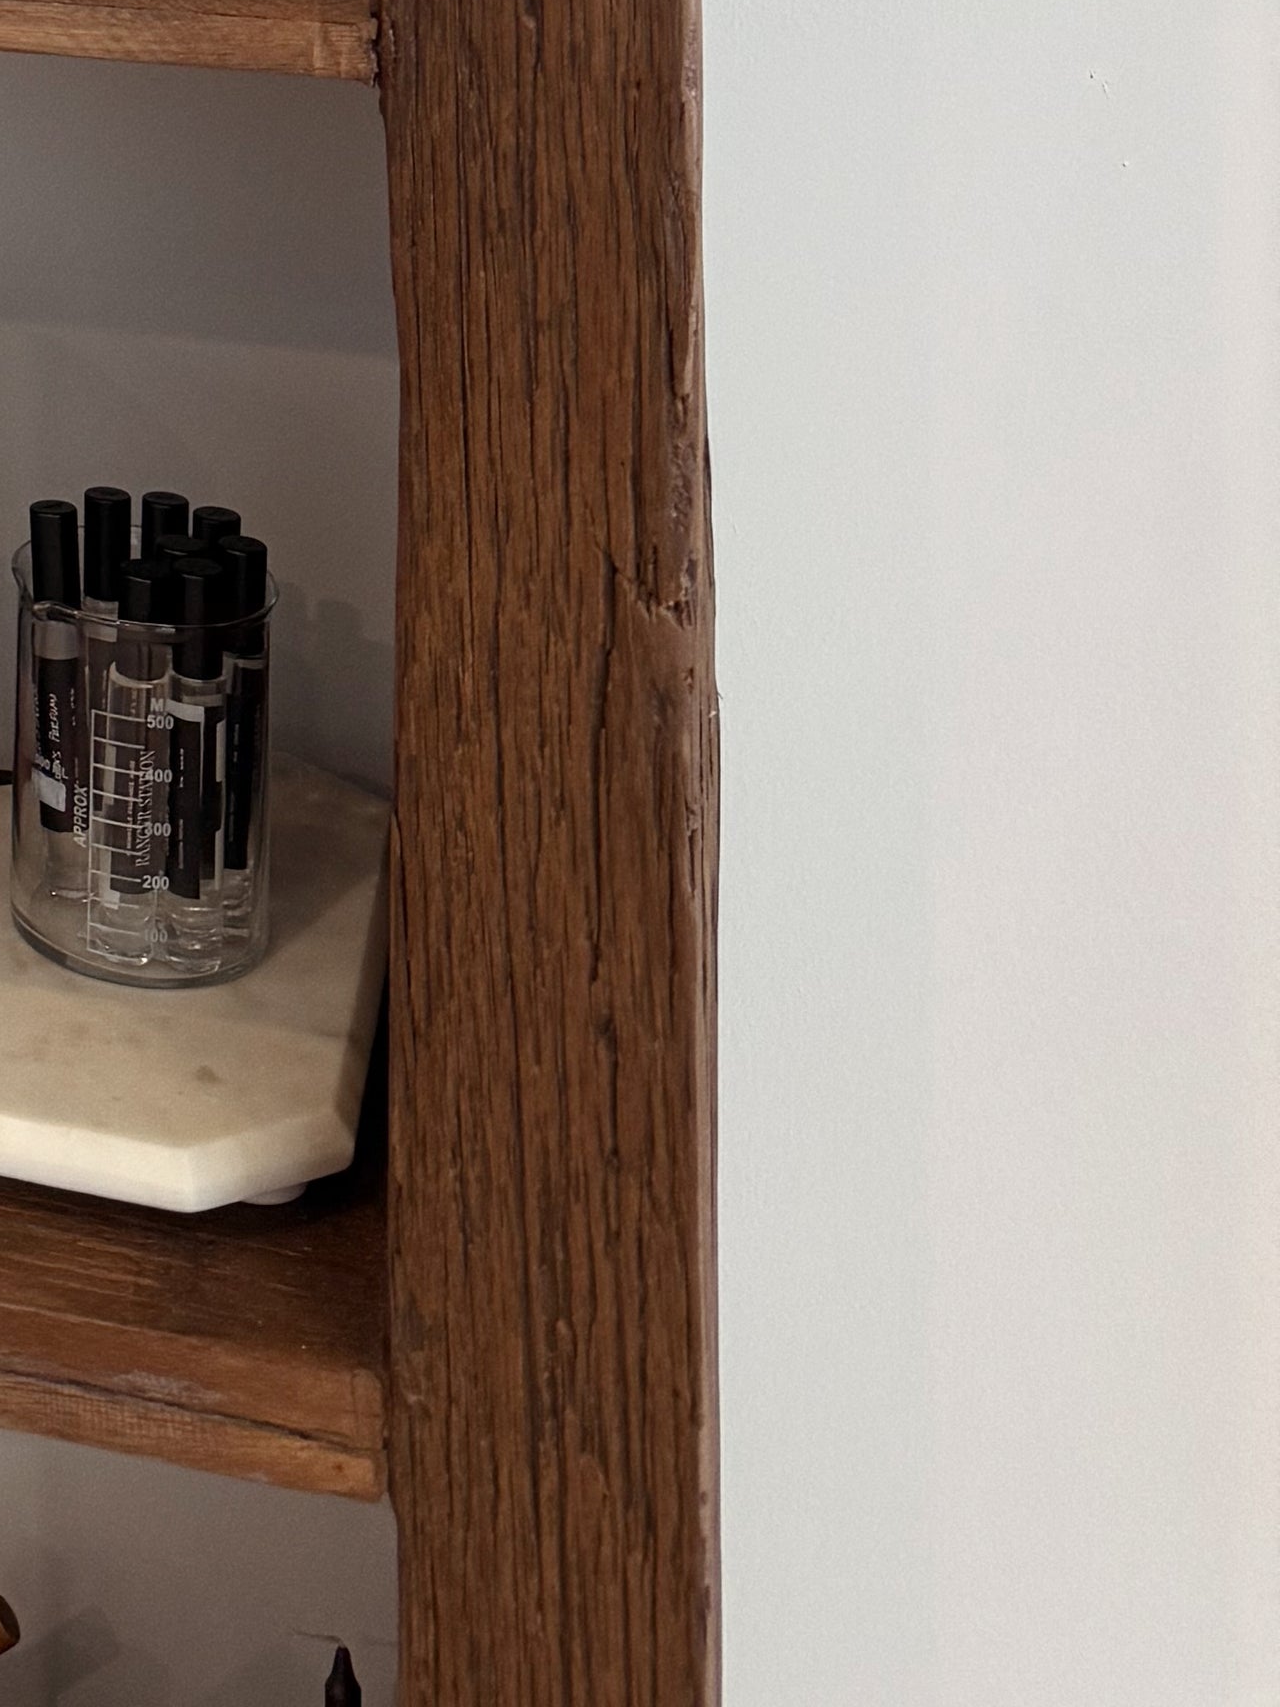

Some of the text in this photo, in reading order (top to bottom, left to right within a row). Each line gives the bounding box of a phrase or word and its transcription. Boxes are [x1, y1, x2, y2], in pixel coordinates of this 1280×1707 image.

[146, 715, 174, 730] 500
[144, 769, 173, 784] 400
[144, 823, 171, 837] 300
[142, 875, 170, 890] 200
